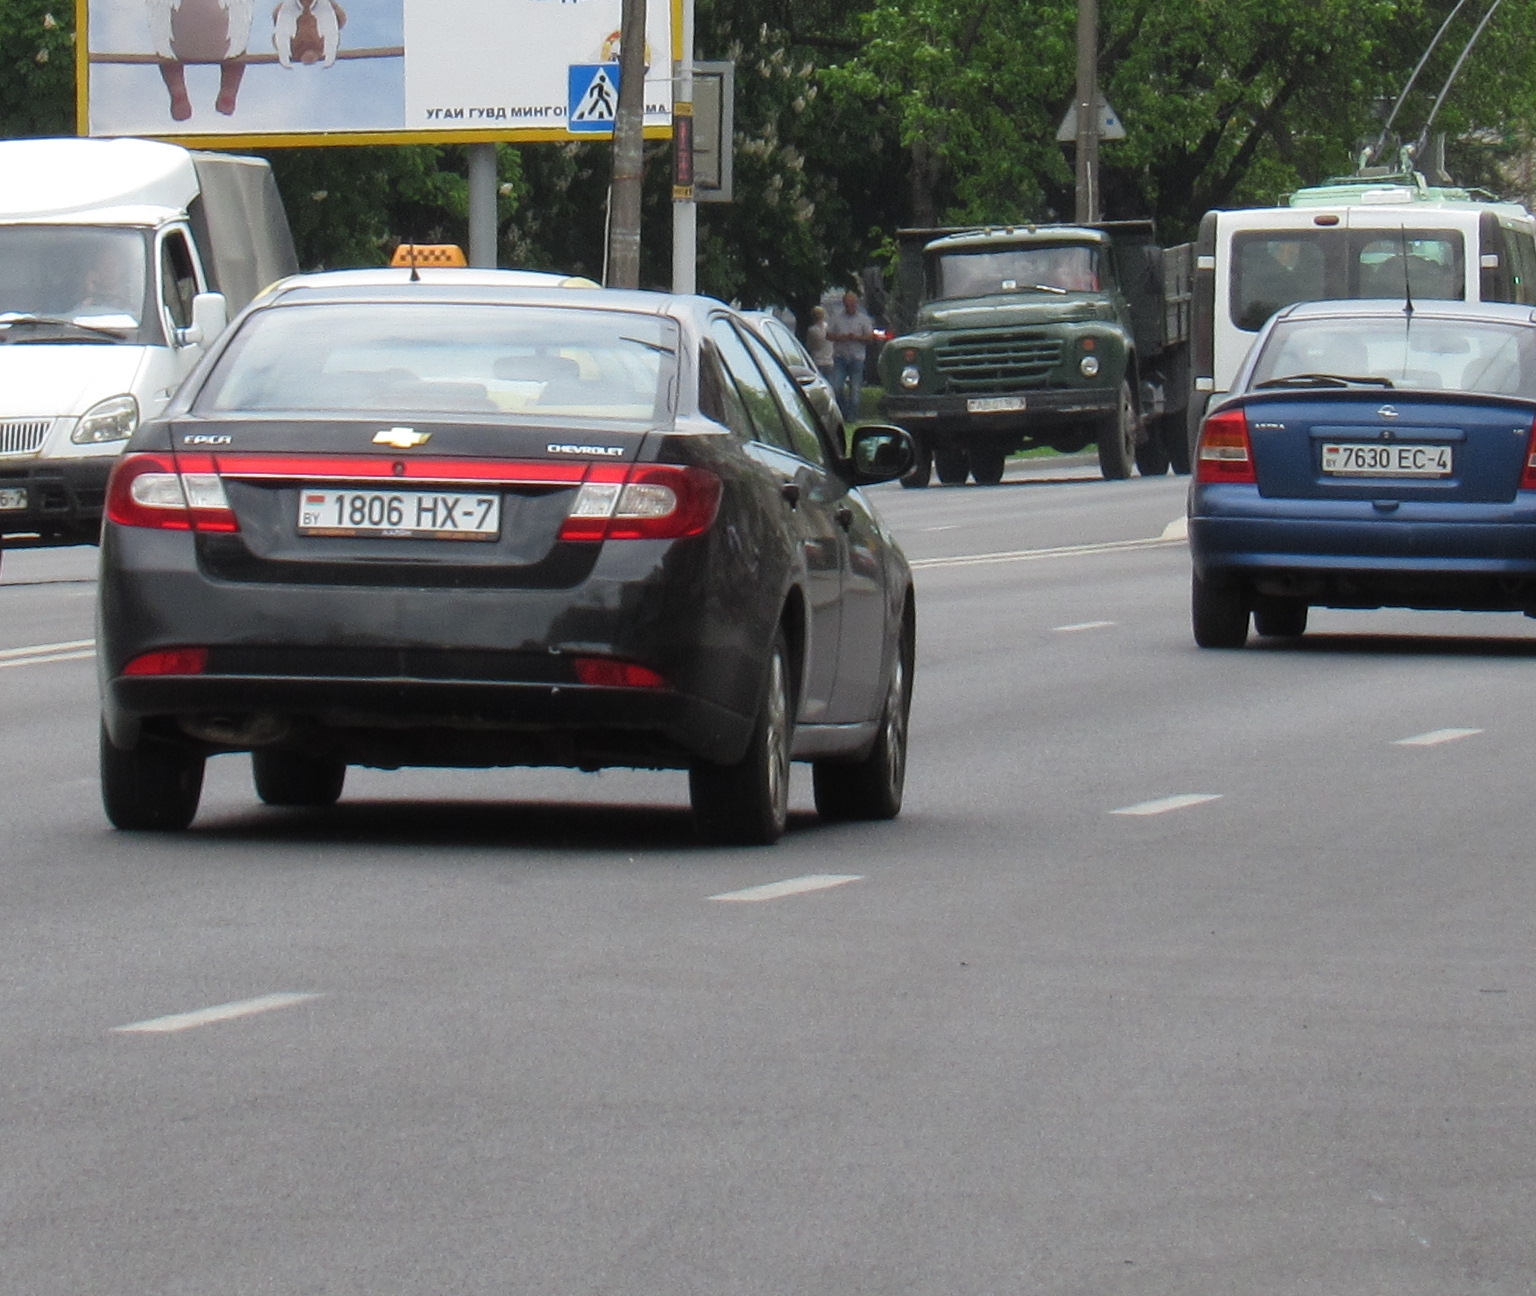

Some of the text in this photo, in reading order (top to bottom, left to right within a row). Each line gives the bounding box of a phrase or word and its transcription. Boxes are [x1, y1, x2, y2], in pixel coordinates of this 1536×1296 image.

[426, 108, 464, 120] УГАИ
[469, 107, 507, 121] ГУВД
[547, 444, 625, 456] CHEVROLET
[1343, 448, 1390, 468] 7630
[1397, 449, 1448, 469] EC-4
[303, 494, 494, 529] BY 1806 HX-7
